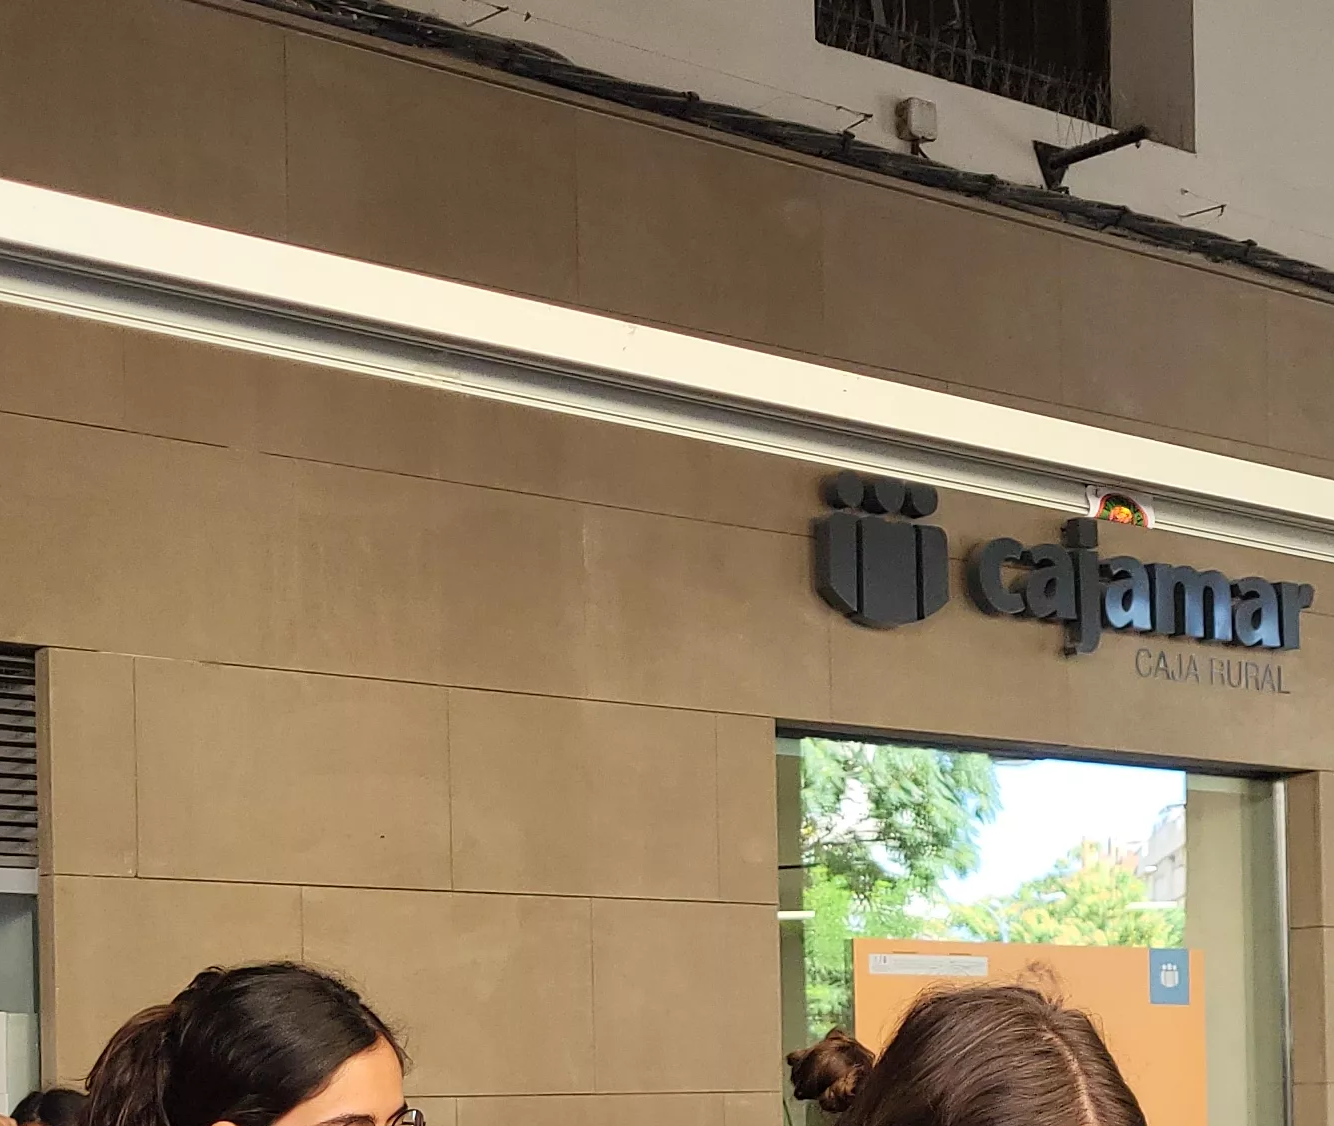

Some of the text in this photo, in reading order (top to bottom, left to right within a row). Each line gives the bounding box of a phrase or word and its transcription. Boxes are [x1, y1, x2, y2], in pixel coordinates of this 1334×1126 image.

[971, 516, 1313, 657] cajamar
[1135, 648, 1290, 695] CAJA RURAL
